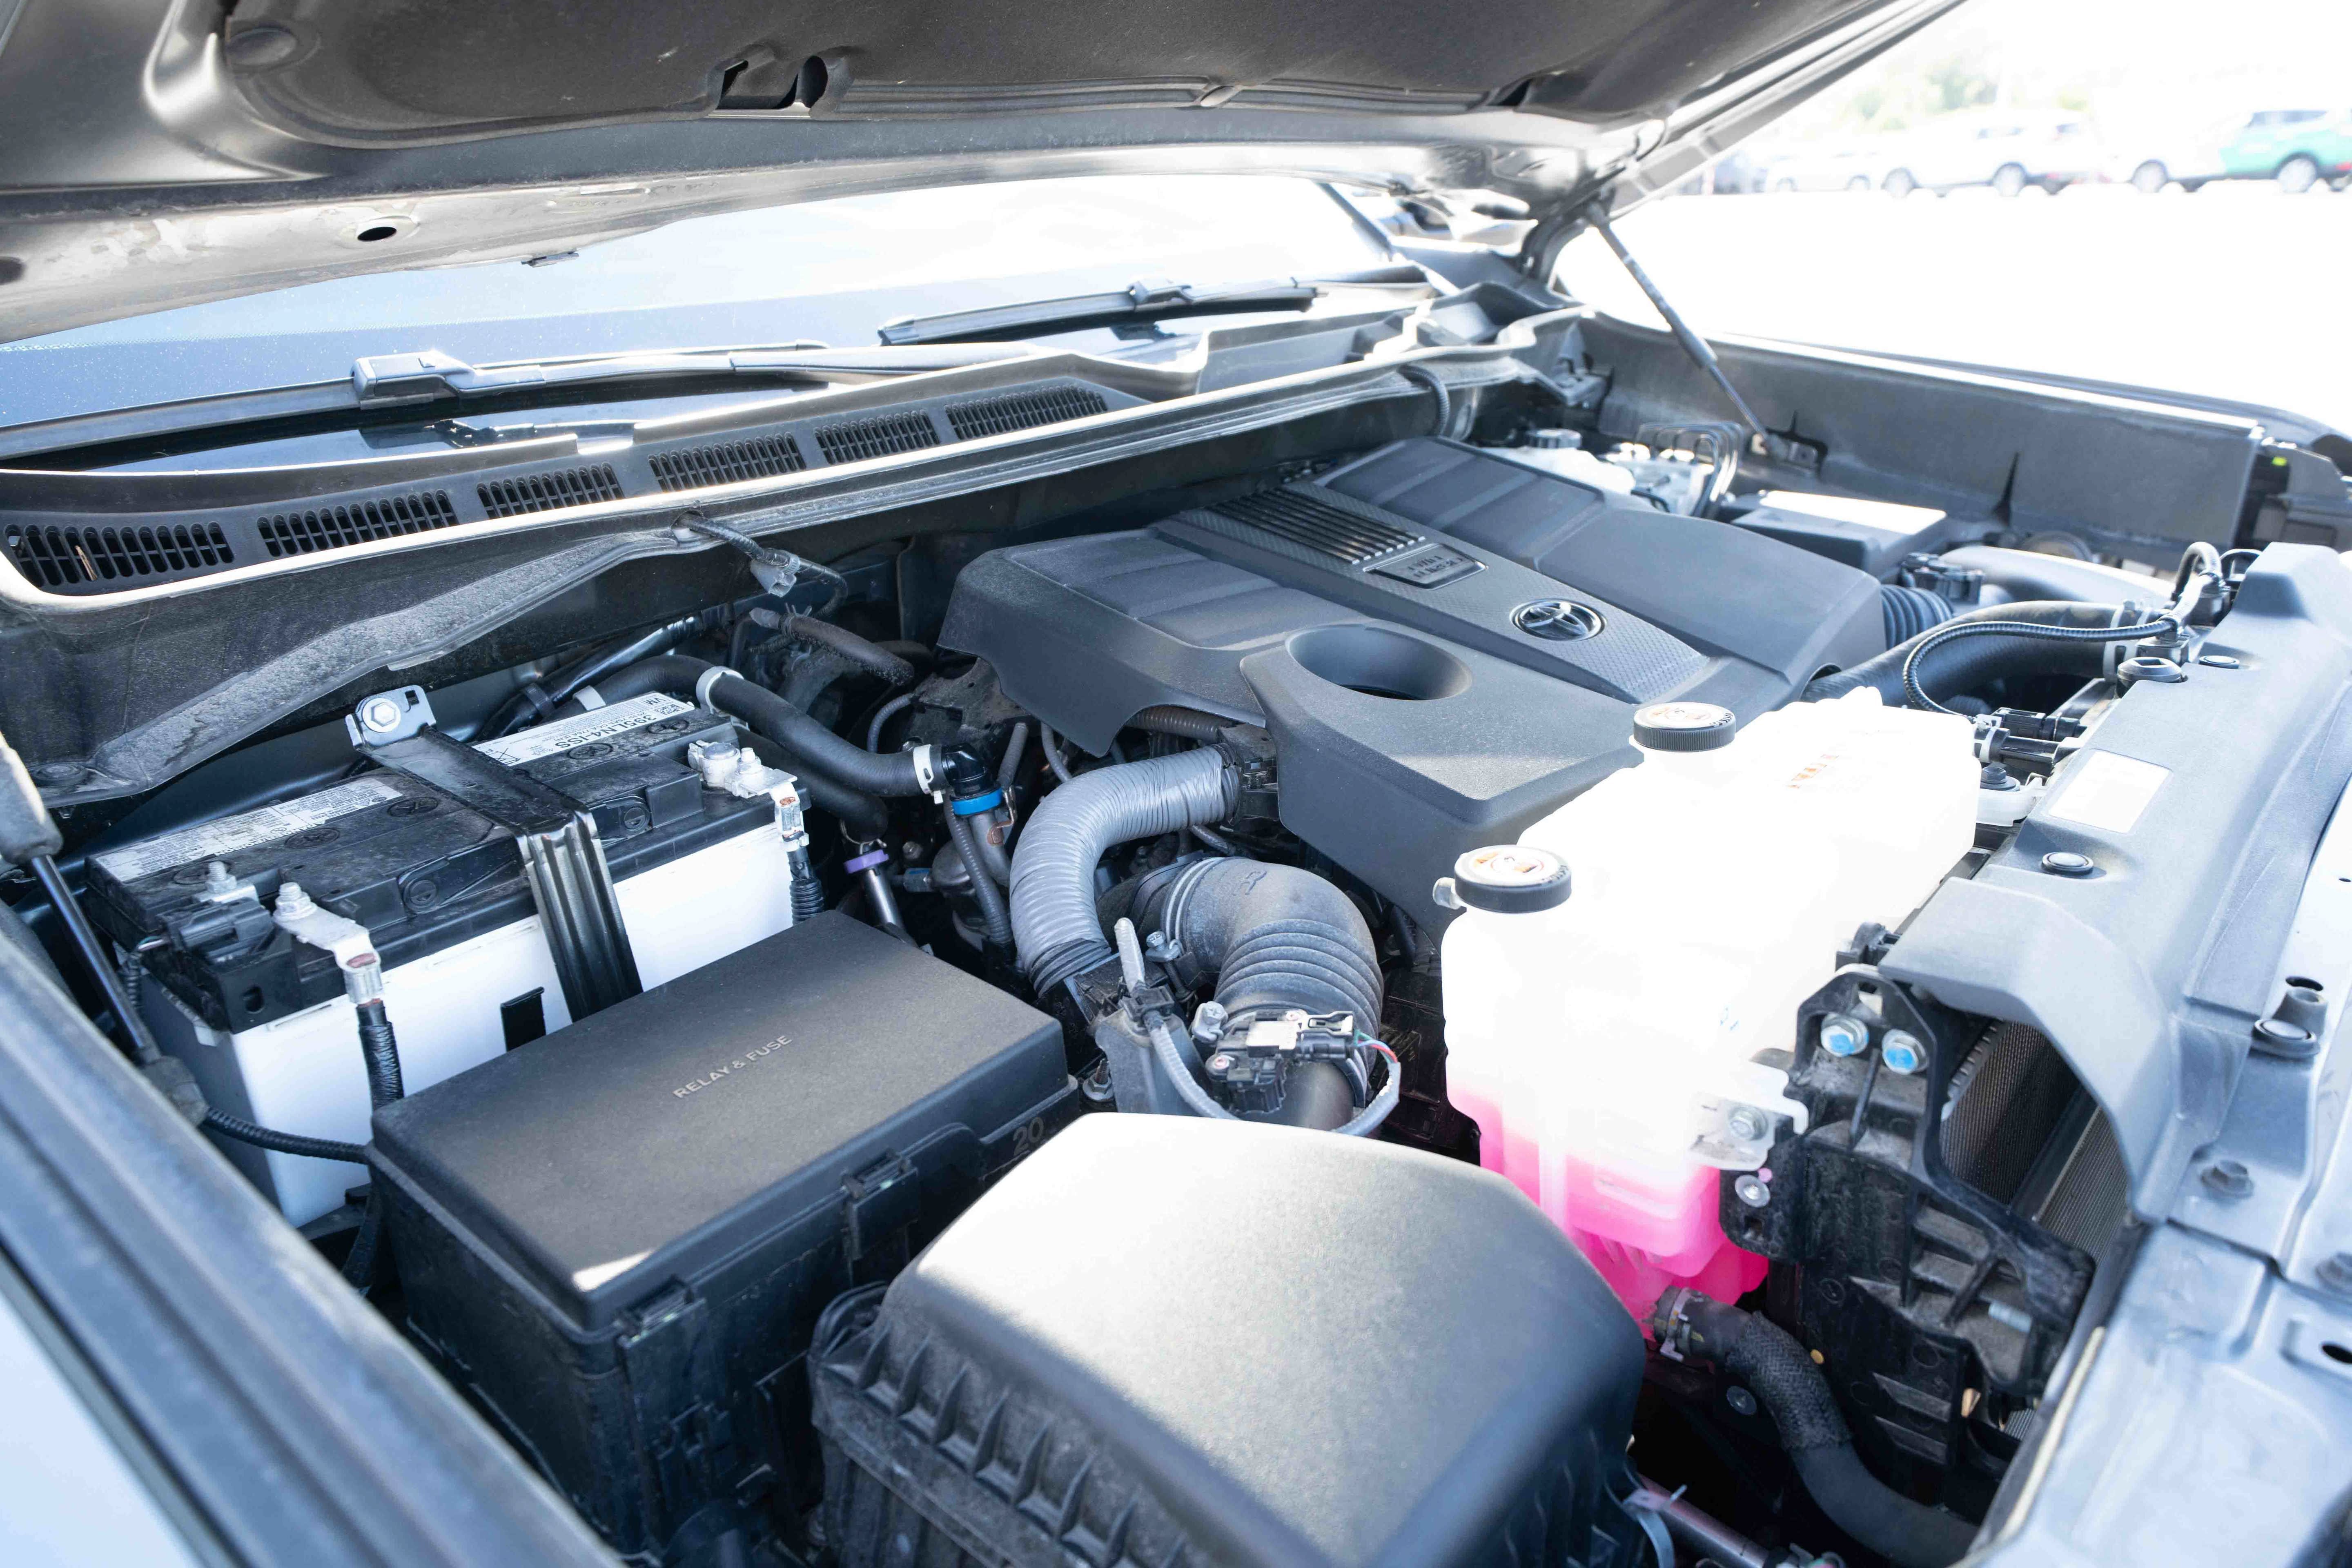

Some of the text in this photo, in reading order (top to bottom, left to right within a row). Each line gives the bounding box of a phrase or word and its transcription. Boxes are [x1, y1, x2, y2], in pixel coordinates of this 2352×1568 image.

[642, 697, 666, 705] VM
[554, 715, 657, 748] 395LN4-ISS
[214, 823, 317, 856] DANGER/POISON
[673, 1035, 793, 1098] RELAY & FUSE
[1013, 1117, 1044, 1156] 20
